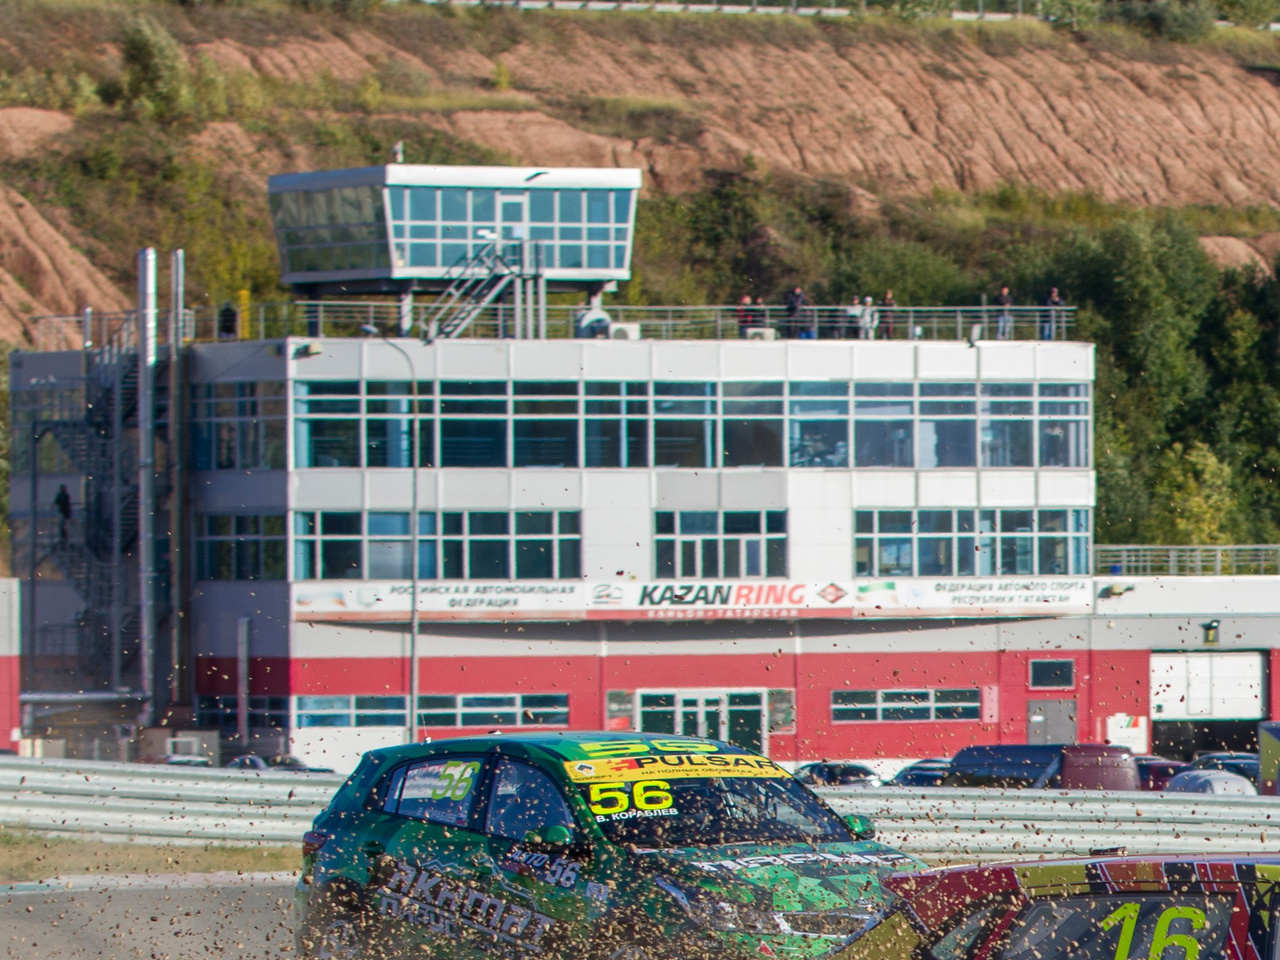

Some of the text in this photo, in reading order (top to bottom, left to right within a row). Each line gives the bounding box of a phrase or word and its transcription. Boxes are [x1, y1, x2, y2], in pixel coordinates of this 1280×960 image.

[473, 585, 576, 595] АВТОМОБИЛЬНАЯ
[934, 582, 993, 593] ФЕДЕРАЦИЯ
[638, 584, 807, 606] KAZANRING
[951, 595, 1014, 604] РЕСПУБЛИКИ
[448, 598, 519, 608] ФЕДЕРАЦИЯ
[715, 609, 799, 618] ТАТАРСТАН
[634, 754, 780, 772] PULSAR
[659, 767, 699, 775] ПОЛНЫХ
[431, 761, 481, 801] 56
[589, 780, 674, 815] 56
[595, 807, 679, 824] В. КОРАБЛЕВ
[545, 858, 581, 888] 56
